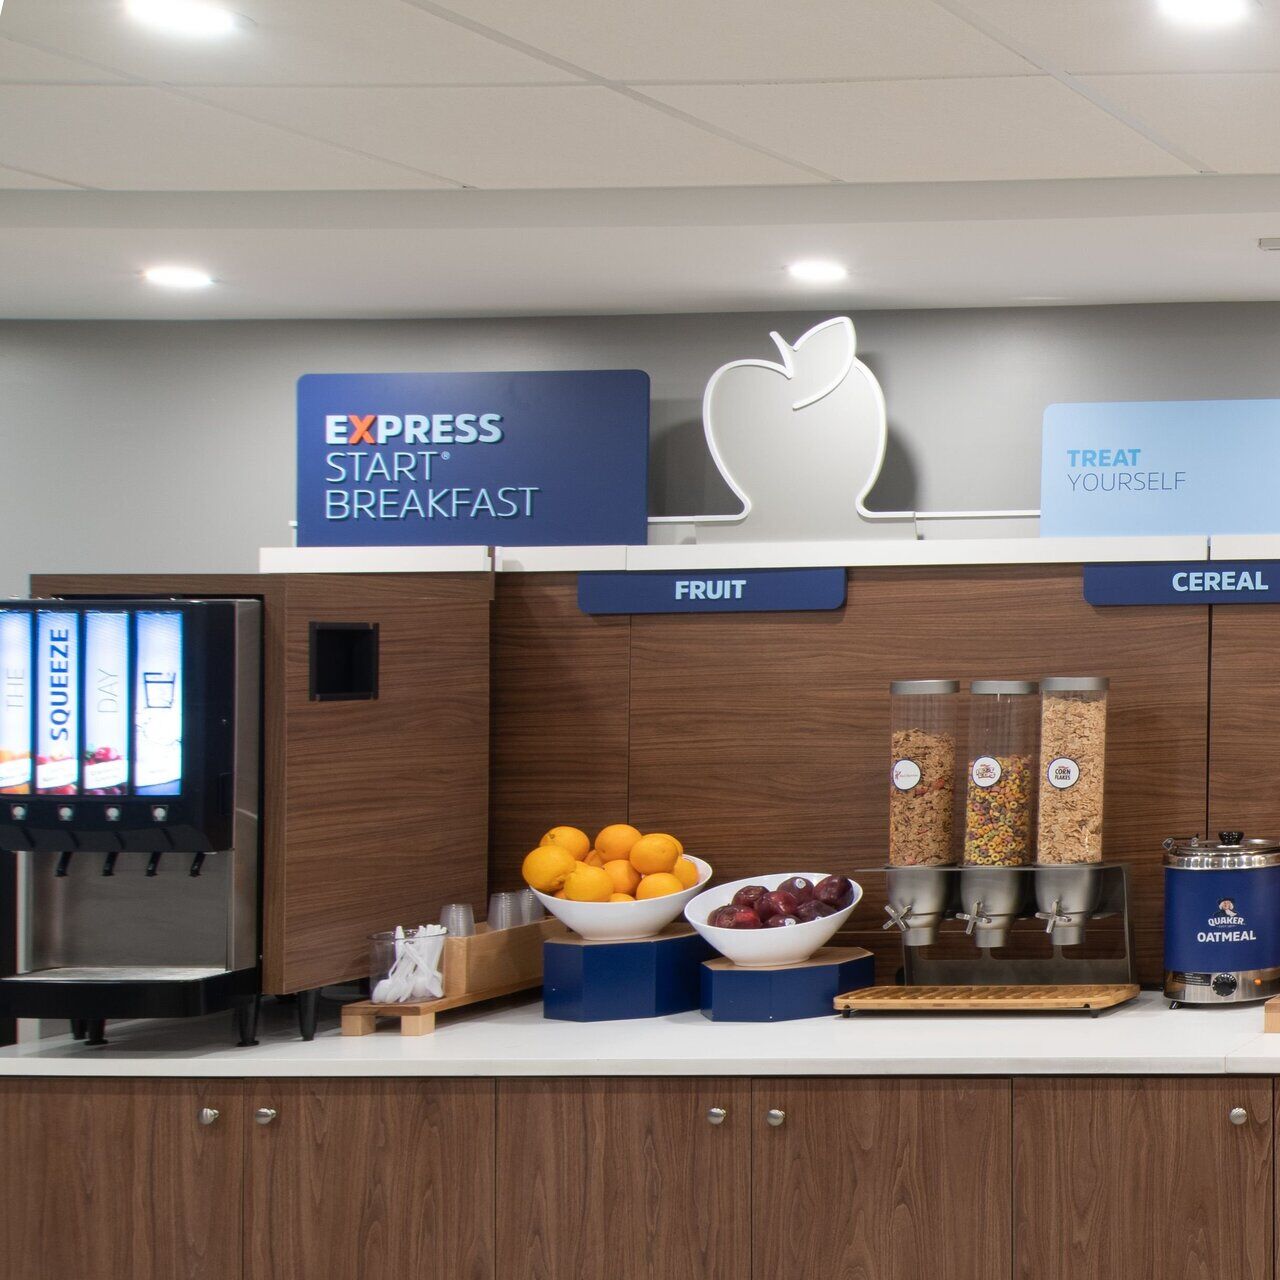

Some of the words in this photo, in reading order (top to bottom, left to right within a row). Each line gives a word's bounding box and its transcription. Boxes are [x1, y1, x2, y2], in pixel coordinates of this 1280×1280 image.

[325, 413, 503, 445] EXPRESS
[1066, 448, 1142, 468] TREAT
[1067, 471, 1187, 492] YOURSELF
[325, 487, 540, 519] BREAKFAST
[675, 579, 747, 600] FRUIT
[1172, 571, 1269, 592] CEREAL
[7, 668, 25, 712] THE
[50, 628, 71, 742] SQUEEZE
[97, 668, 119, 714] DAY
[1208, 916, 1245, 927] QUAKER
[1197, 930, 1257, 943] OATMEAL
